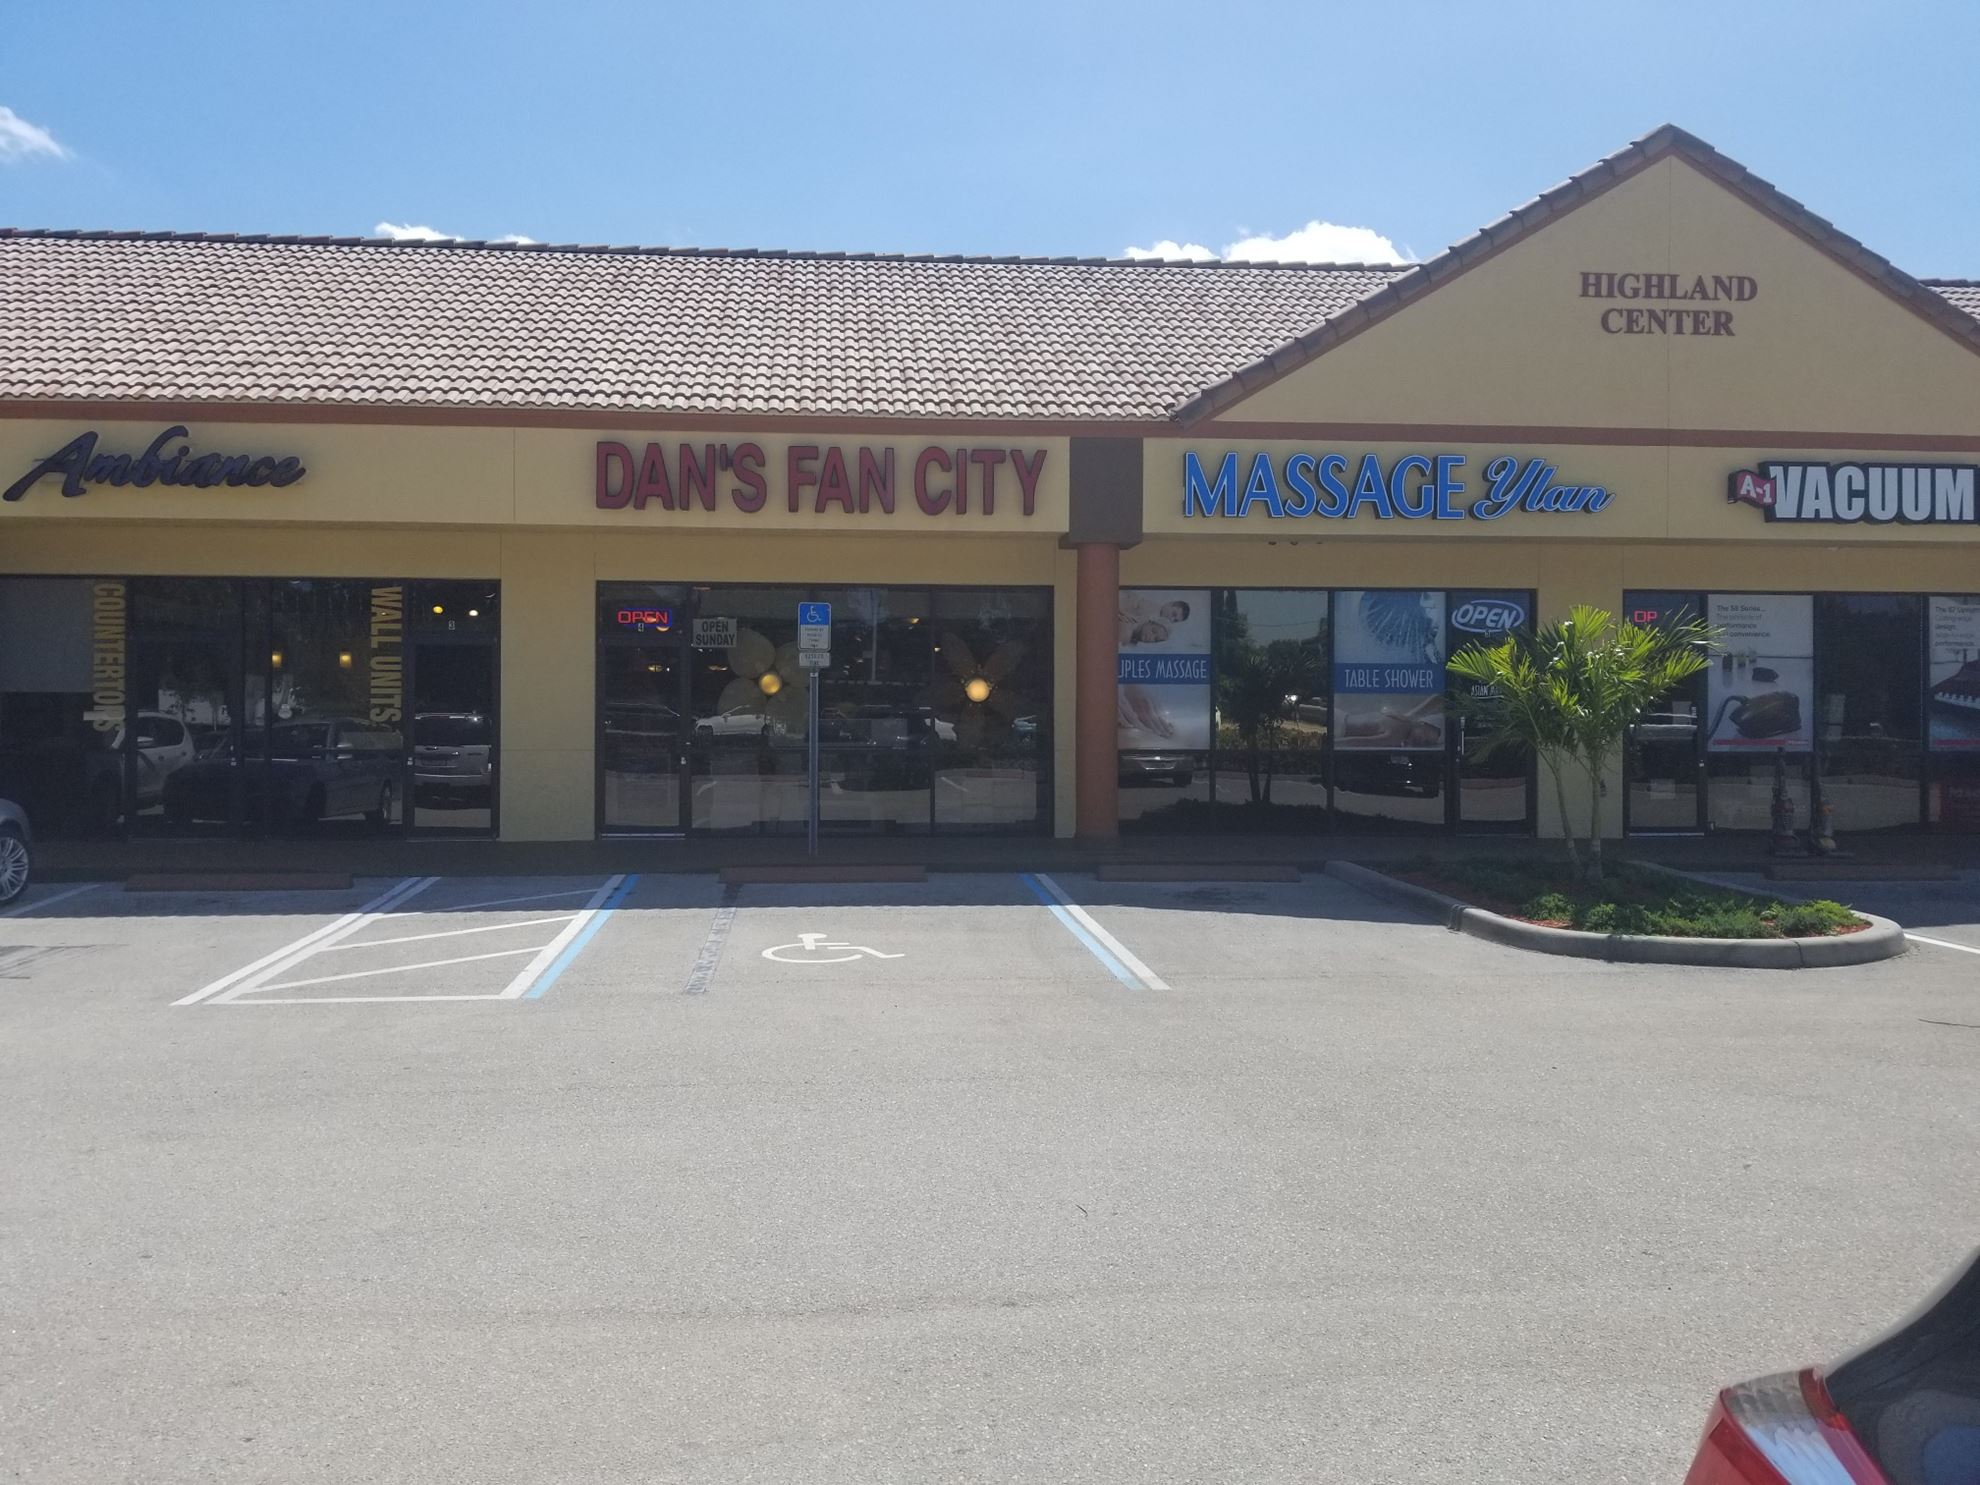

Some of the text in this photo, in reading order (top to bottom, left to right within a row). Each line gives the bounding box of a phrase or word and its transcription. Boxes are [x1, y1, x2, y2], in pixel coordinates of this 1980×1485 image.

[1580, 272, 1758, 301] HIGHLAND
[1601, 308, 1735, 336] CENTER
[3, 425, 306, 501] Ambiance
[596, 440, 1048, 516] DAN'S FAN CITY
[1183, 451, 1615, 521] MASSAGE Ylan
[1740, 465, 1975, 521] A-1 VACUUM
[617, 610, 669, 625] OPEN
[702, 621, 729, 633] OPEN
[1456, 604, 1517, 629] OPEN
[370, 586, 402, 722] WALL UNITS
[695, 634, 735, 646] SUNDAY
[93, 583, 126, 731] COUNTERTOPS
[1155, 659, 1207, 678] MASSAGE
[1345, 669, 1433, 689] TABLE SHOWER
